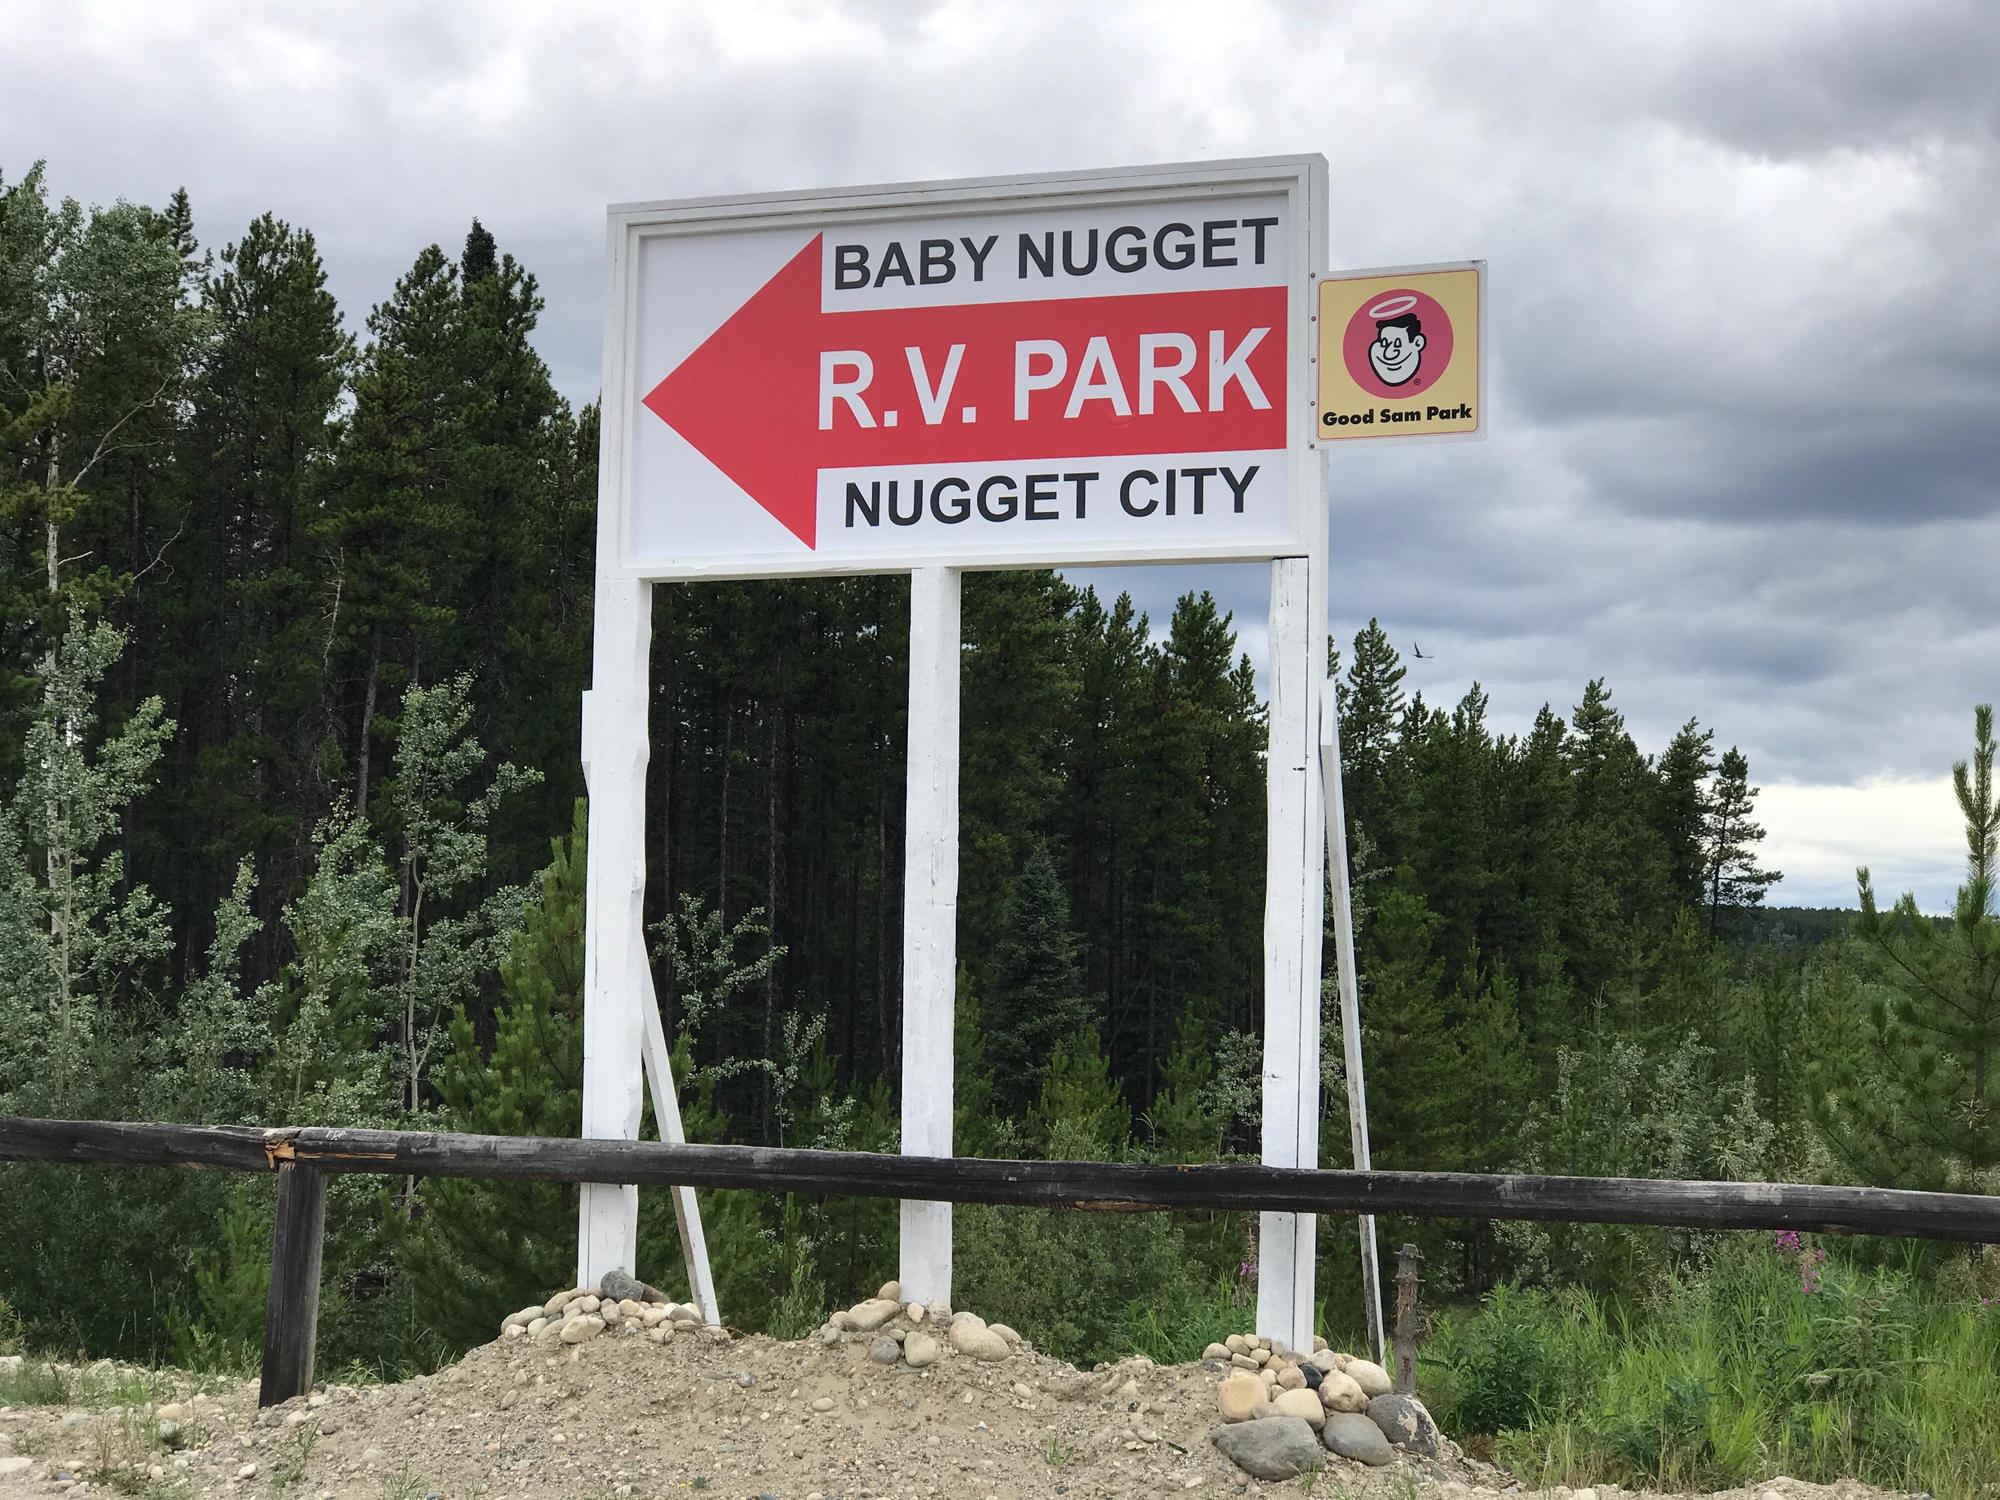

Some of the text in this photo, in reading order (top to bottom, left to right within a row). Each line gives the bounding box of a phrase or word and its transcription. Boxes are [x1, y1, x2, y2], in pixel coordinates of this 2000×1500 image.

[835, 218, 1278, 290] BABY NUGGET
[818, 327, 1272, 431] R.V. PARK
[1322, 403, 1472, 426] Good Sam Park
[845, 465, 1261, 528] NUGGET CITY
